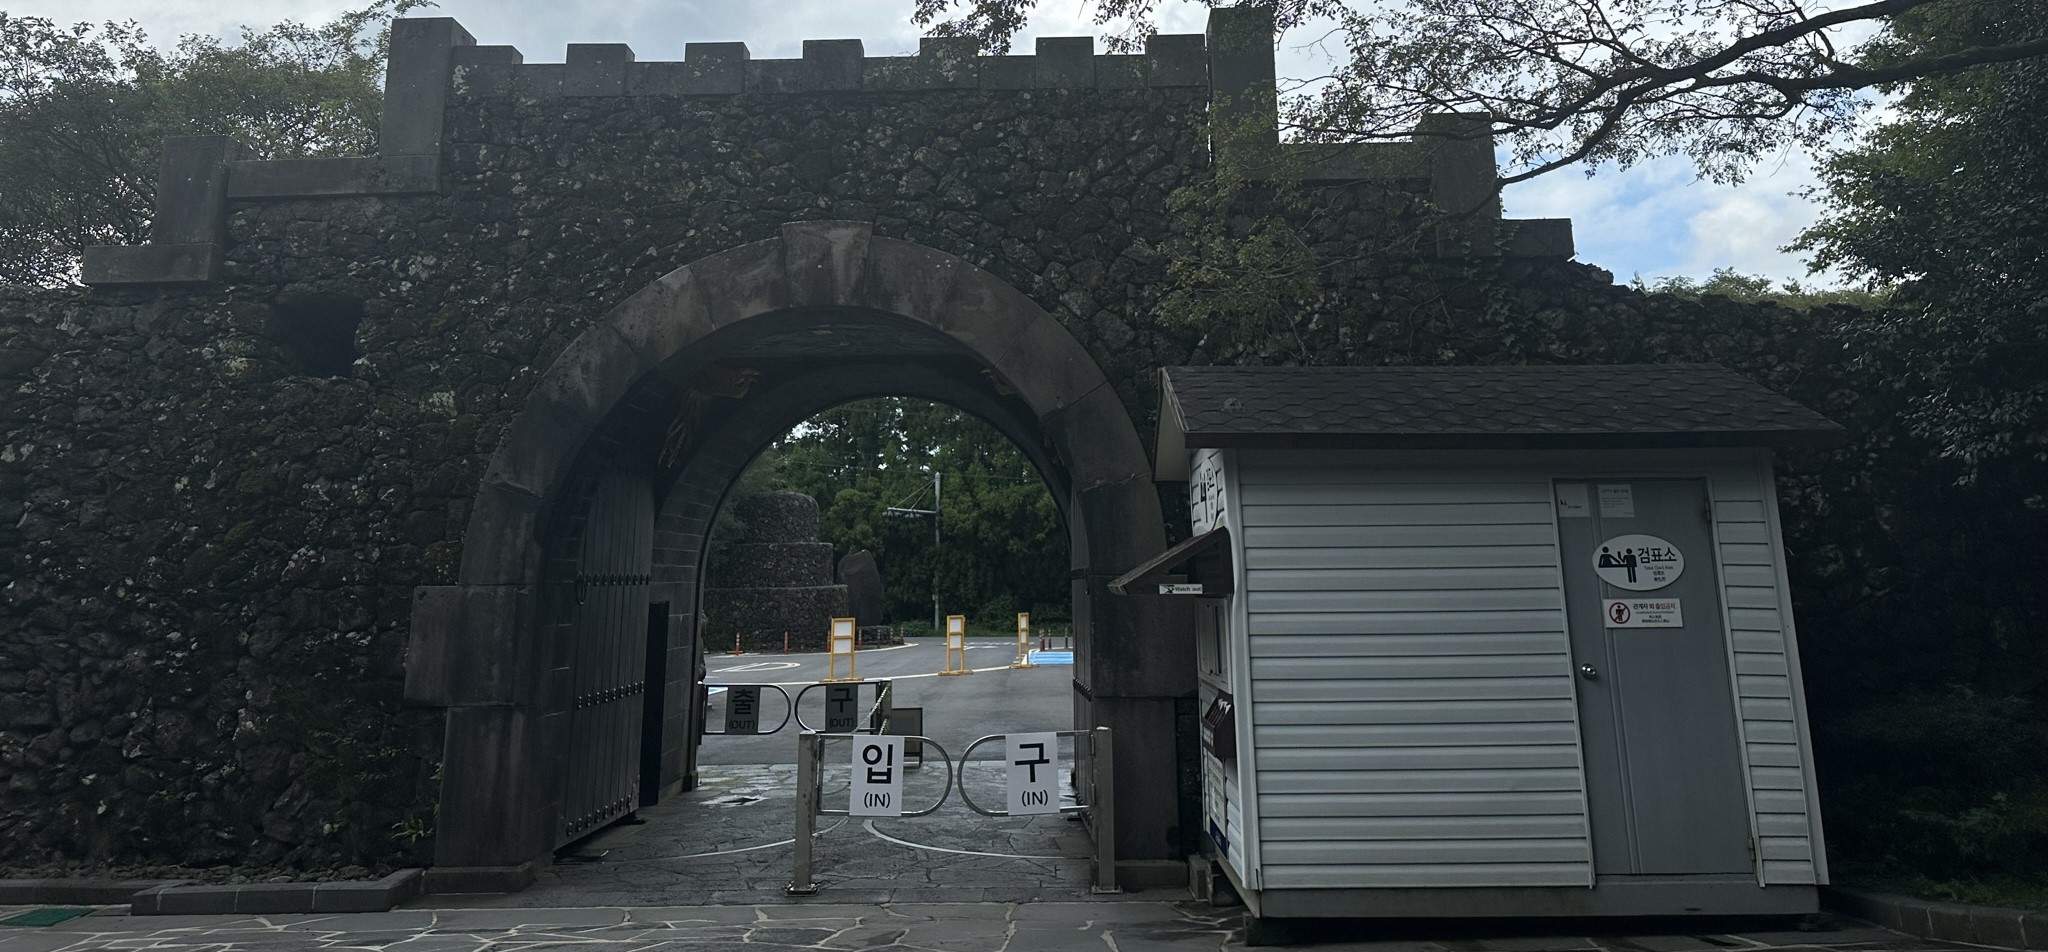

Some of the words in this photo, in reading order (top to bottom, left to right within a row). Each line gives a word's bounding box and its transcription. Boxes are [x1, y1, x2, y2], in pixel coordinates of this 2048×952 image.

[1638, 547, 1677, 563] 검표소
[732, 688, 755, 715] 출
[831, 687, 853, 713] 구
[729, 719, 755, 730] (OUT)
[829, 717, 854, 729] (OUT)
[862, 744, 893, 784] 입
[1014, 743, 1050, 783] 구
[863, 792, 891, 808] (IN)
[1021, 789, 1048, 807] (IN)
